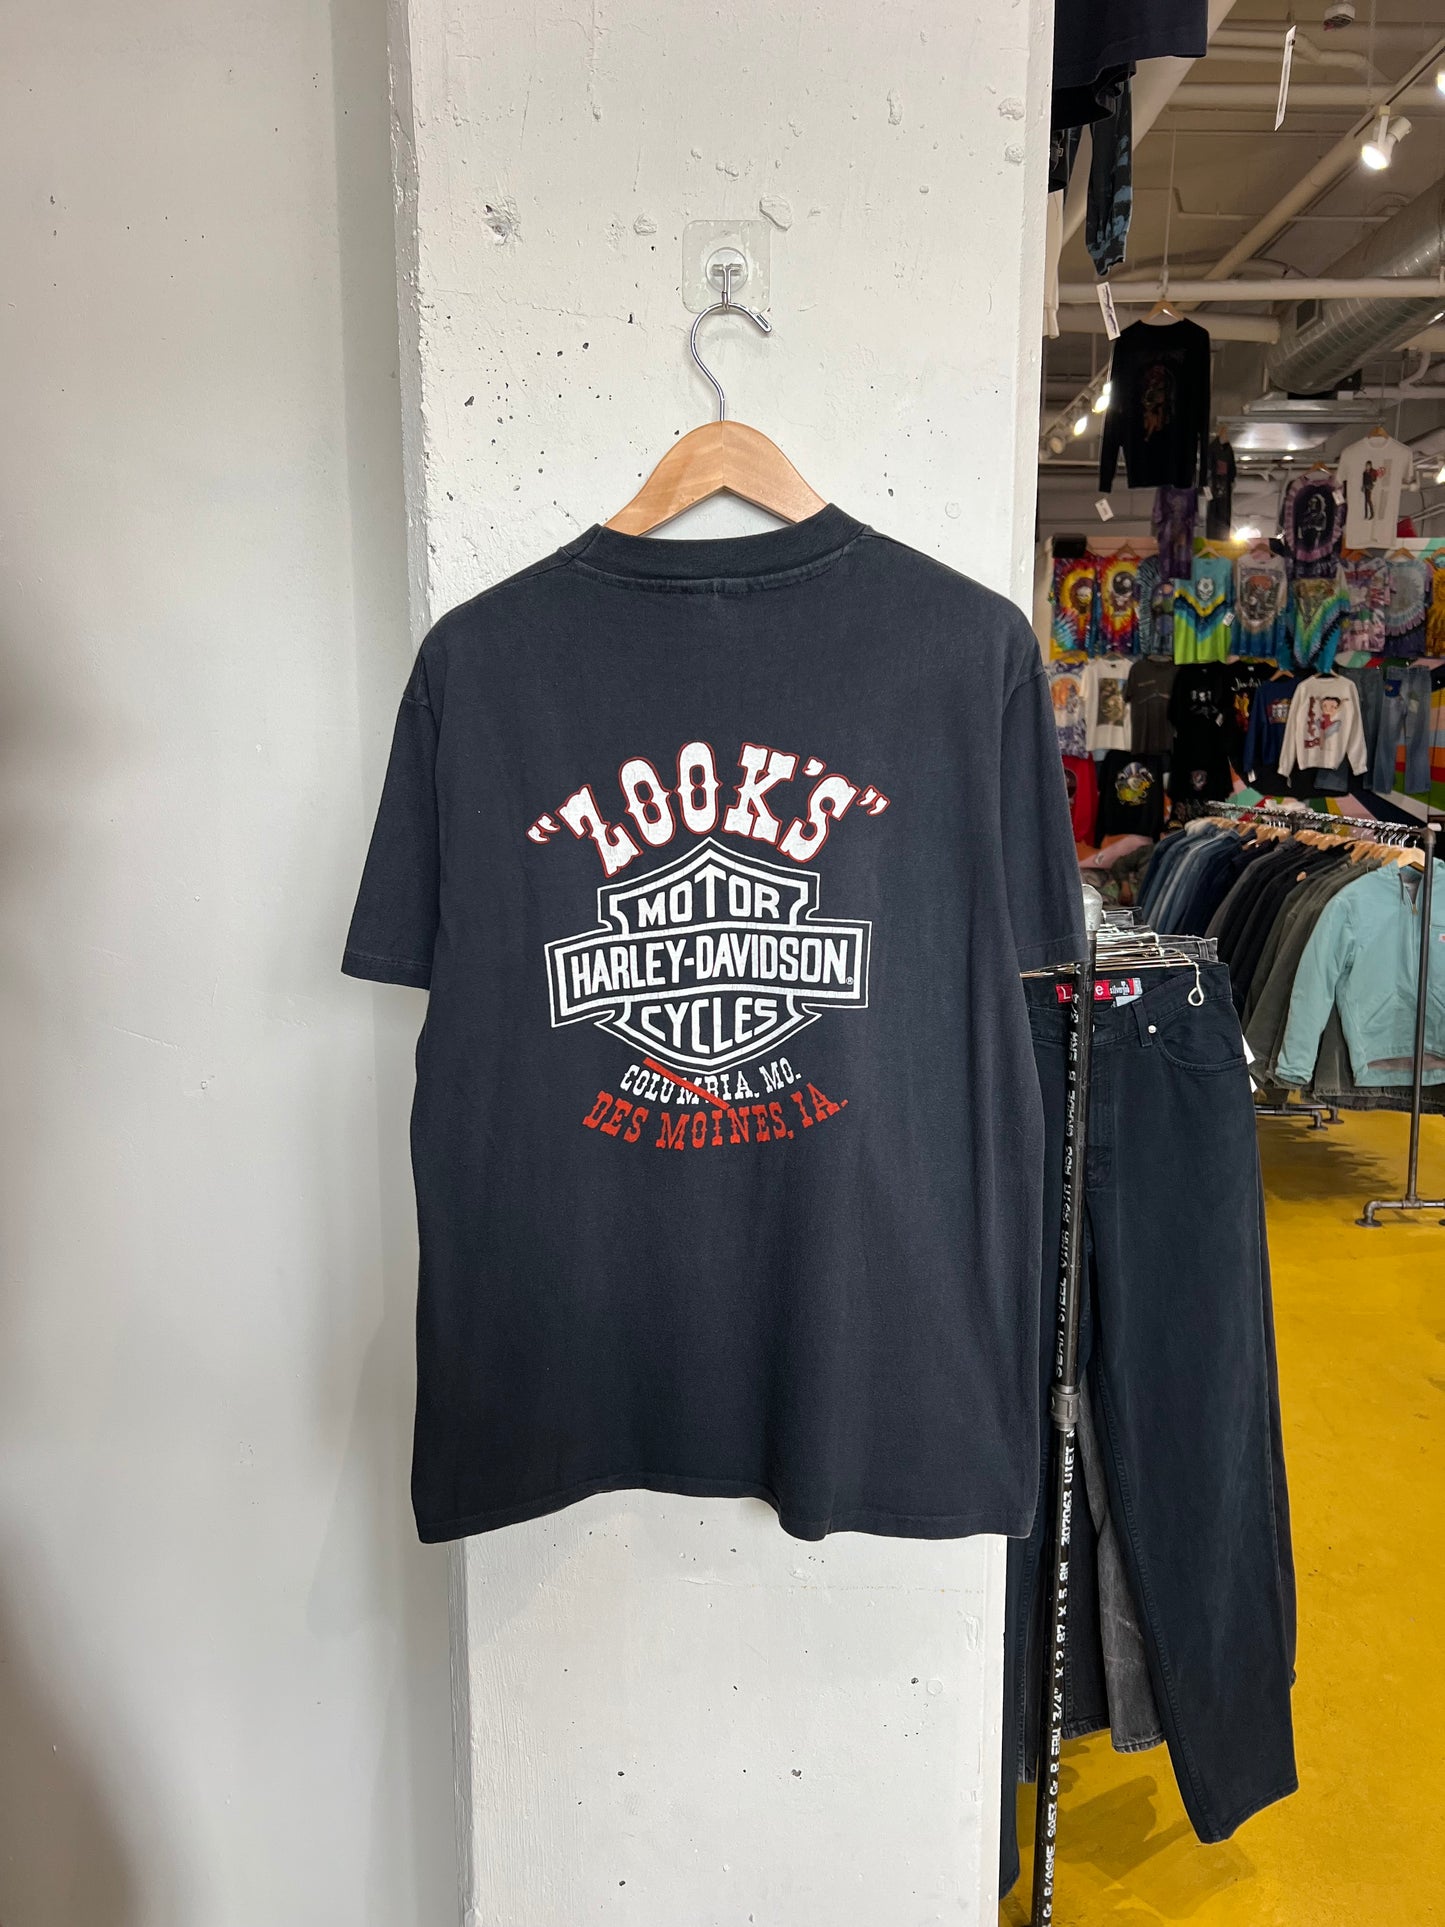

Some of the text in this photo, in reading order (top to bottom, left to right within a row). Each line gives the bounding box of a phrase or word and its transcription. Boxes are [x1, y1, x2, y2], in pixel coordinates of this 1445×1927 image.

[638, 864, 780, 927] MOTOR
[641, 996, 778, 1054] CYCLES
[758, 1057, 802, 1094] MO.
[582, 1082, 849, 1151] DES MOINES, IA.
[1057, 1606, 1067, 1617] X
[1055, 1666, 1064, 1678] X
